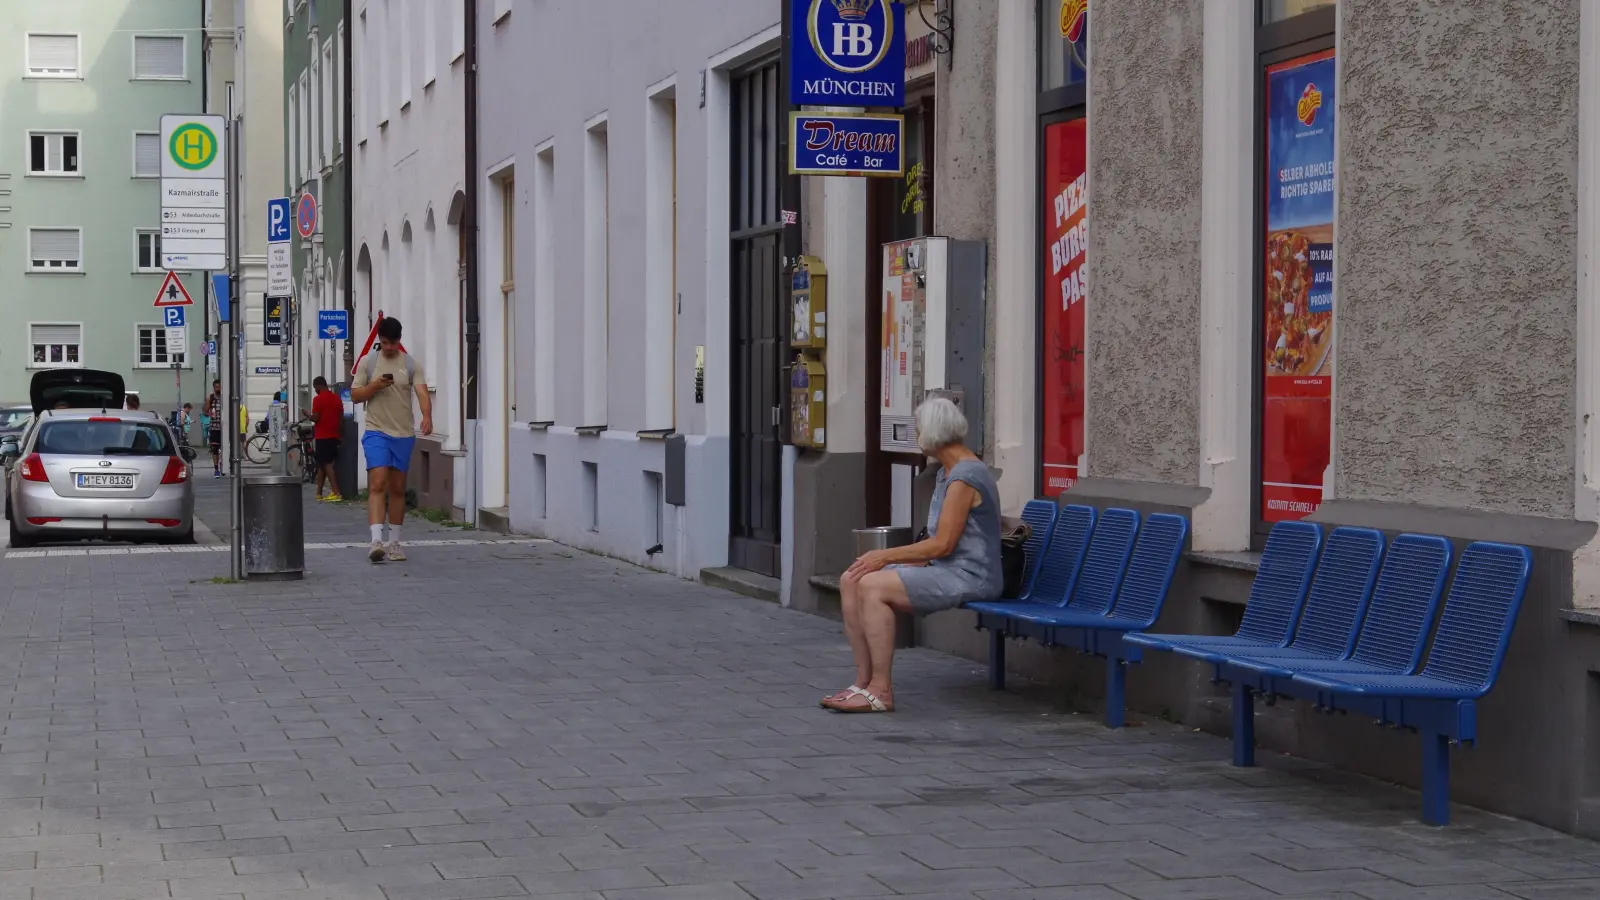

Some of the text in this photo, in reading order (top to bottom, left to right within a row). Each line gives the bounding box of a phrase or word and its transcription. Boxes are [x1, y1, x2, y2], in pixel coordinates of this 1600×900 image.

[831, 22, 873, 56] HB
[803, 78, 895, 97] MÜNCHEN
[803, 120, 896, 153] Dream
[184, 133, 203, 160] H
[815, 153, 883, 168] Café Bar
[1280, 166, 1304, 183] SELBER
[168, 189, 219, 197] Kazmairstraße
[1280, 182, 1308, 199] RICHTIG
[169, 211, 177, 219] 53
[271, 204, 284, 237] P
[1309, 250, 1320, 261] 10%
[1314, 272, 1326, 284] AUF
[166, 308, 179, 325] P
[320, 313, 346, 321] Parkschein
[83, 475, 131, 485] M EY 8136
